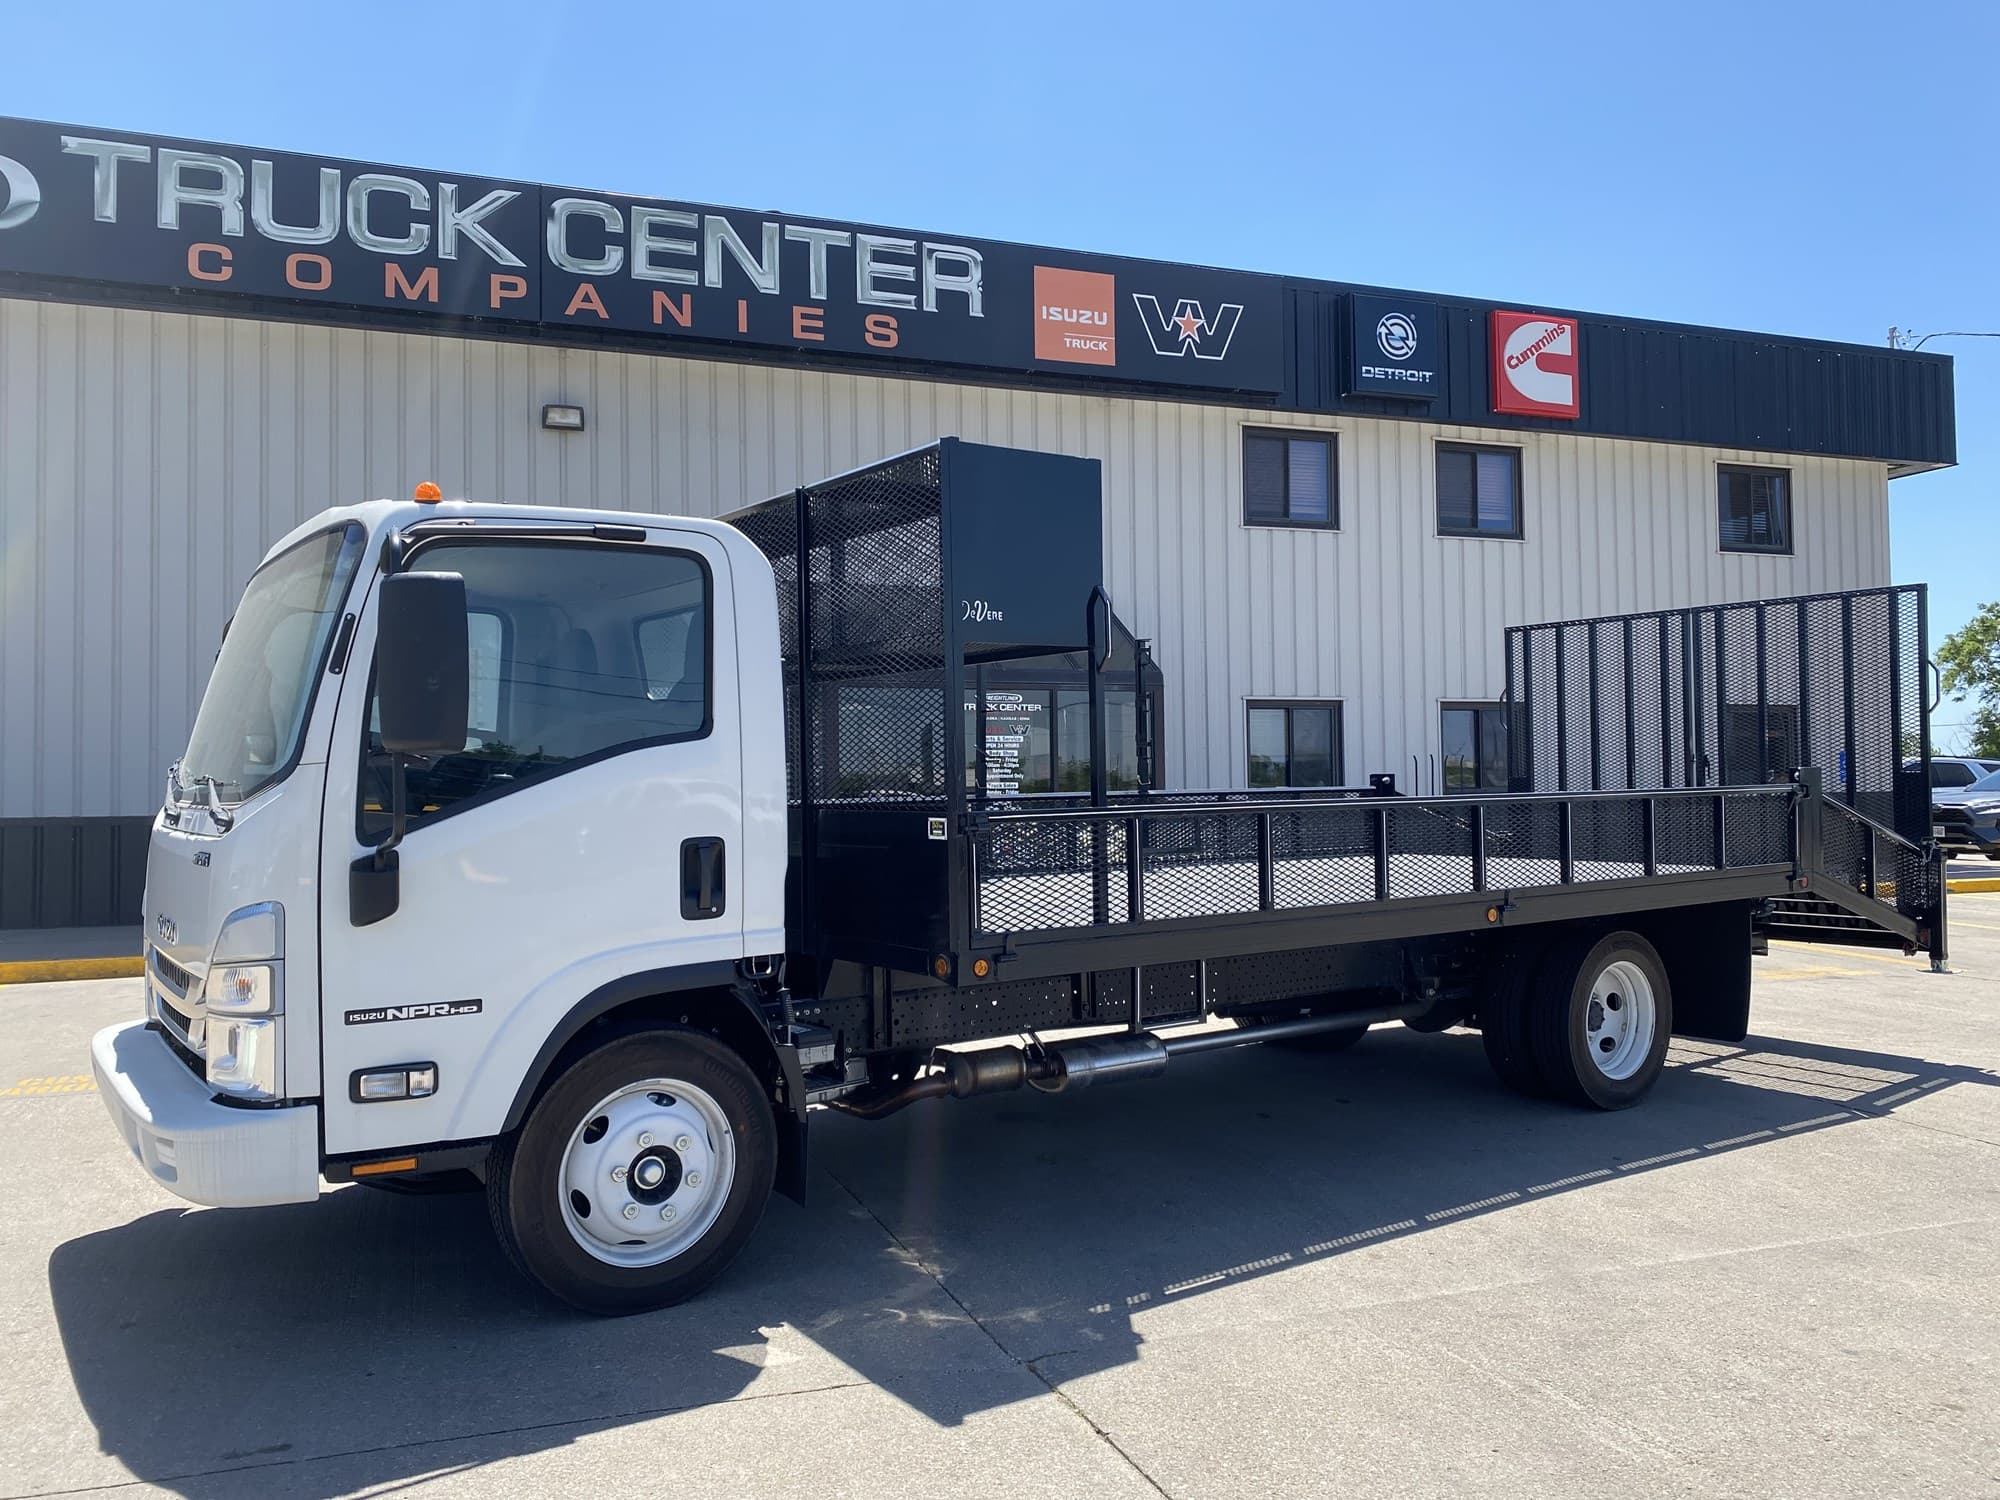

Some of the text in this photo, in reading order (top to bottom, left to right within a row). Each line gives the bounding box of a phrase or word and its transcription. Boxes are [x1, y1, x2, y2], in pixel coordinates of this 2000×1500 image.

[60, 135, 985, 318] TRUCK CENTER
[186, 242, 900, 349] COMPANIES
[1041, 305, 1108, 326] ISUZU
[1064, 337, 1108, 352] TRUCK
[1506, 323, 1566, 370] Cummins
[1361, 365, 1433, 383] DETROIT
[1000, 703, 1042, 711] CENTER
[349, 1003, 478, 1022] ISUZU NPR HD
